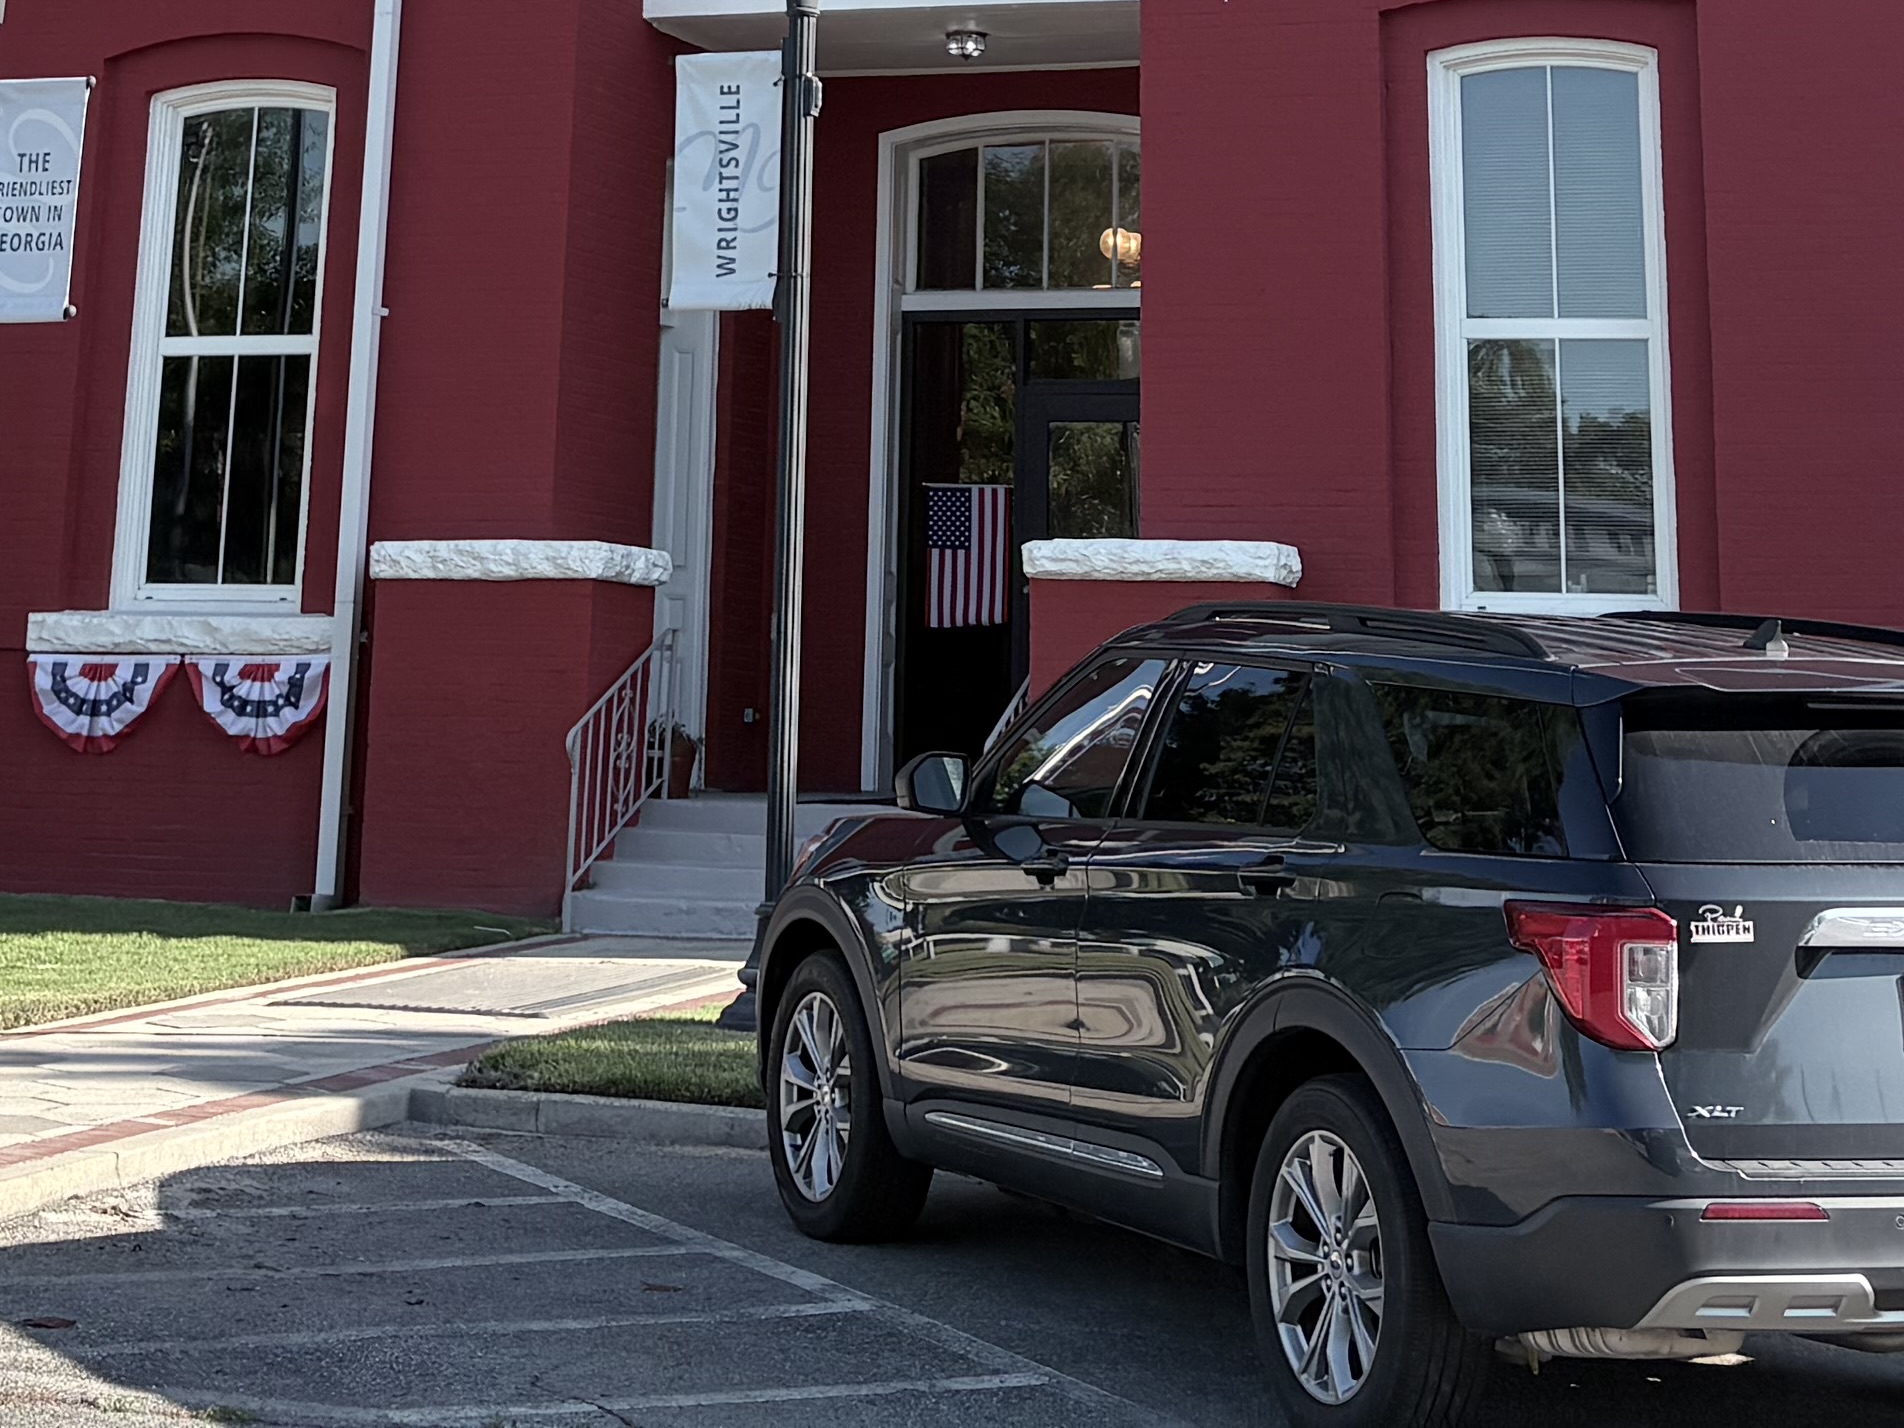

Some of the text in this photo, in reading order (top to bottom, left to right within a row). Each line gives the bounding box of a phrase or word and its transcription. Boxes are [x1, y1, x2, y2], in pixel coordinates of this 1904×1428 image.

[17, 152, 51, 173] THE
[715, 84, 741, 278] WRIGHTSVILLE
[46, 205, 63, 222] IN
[1693, 924, 1751, 936] THIGPEN
[1686, 1105, 1745, 1118] XLT
